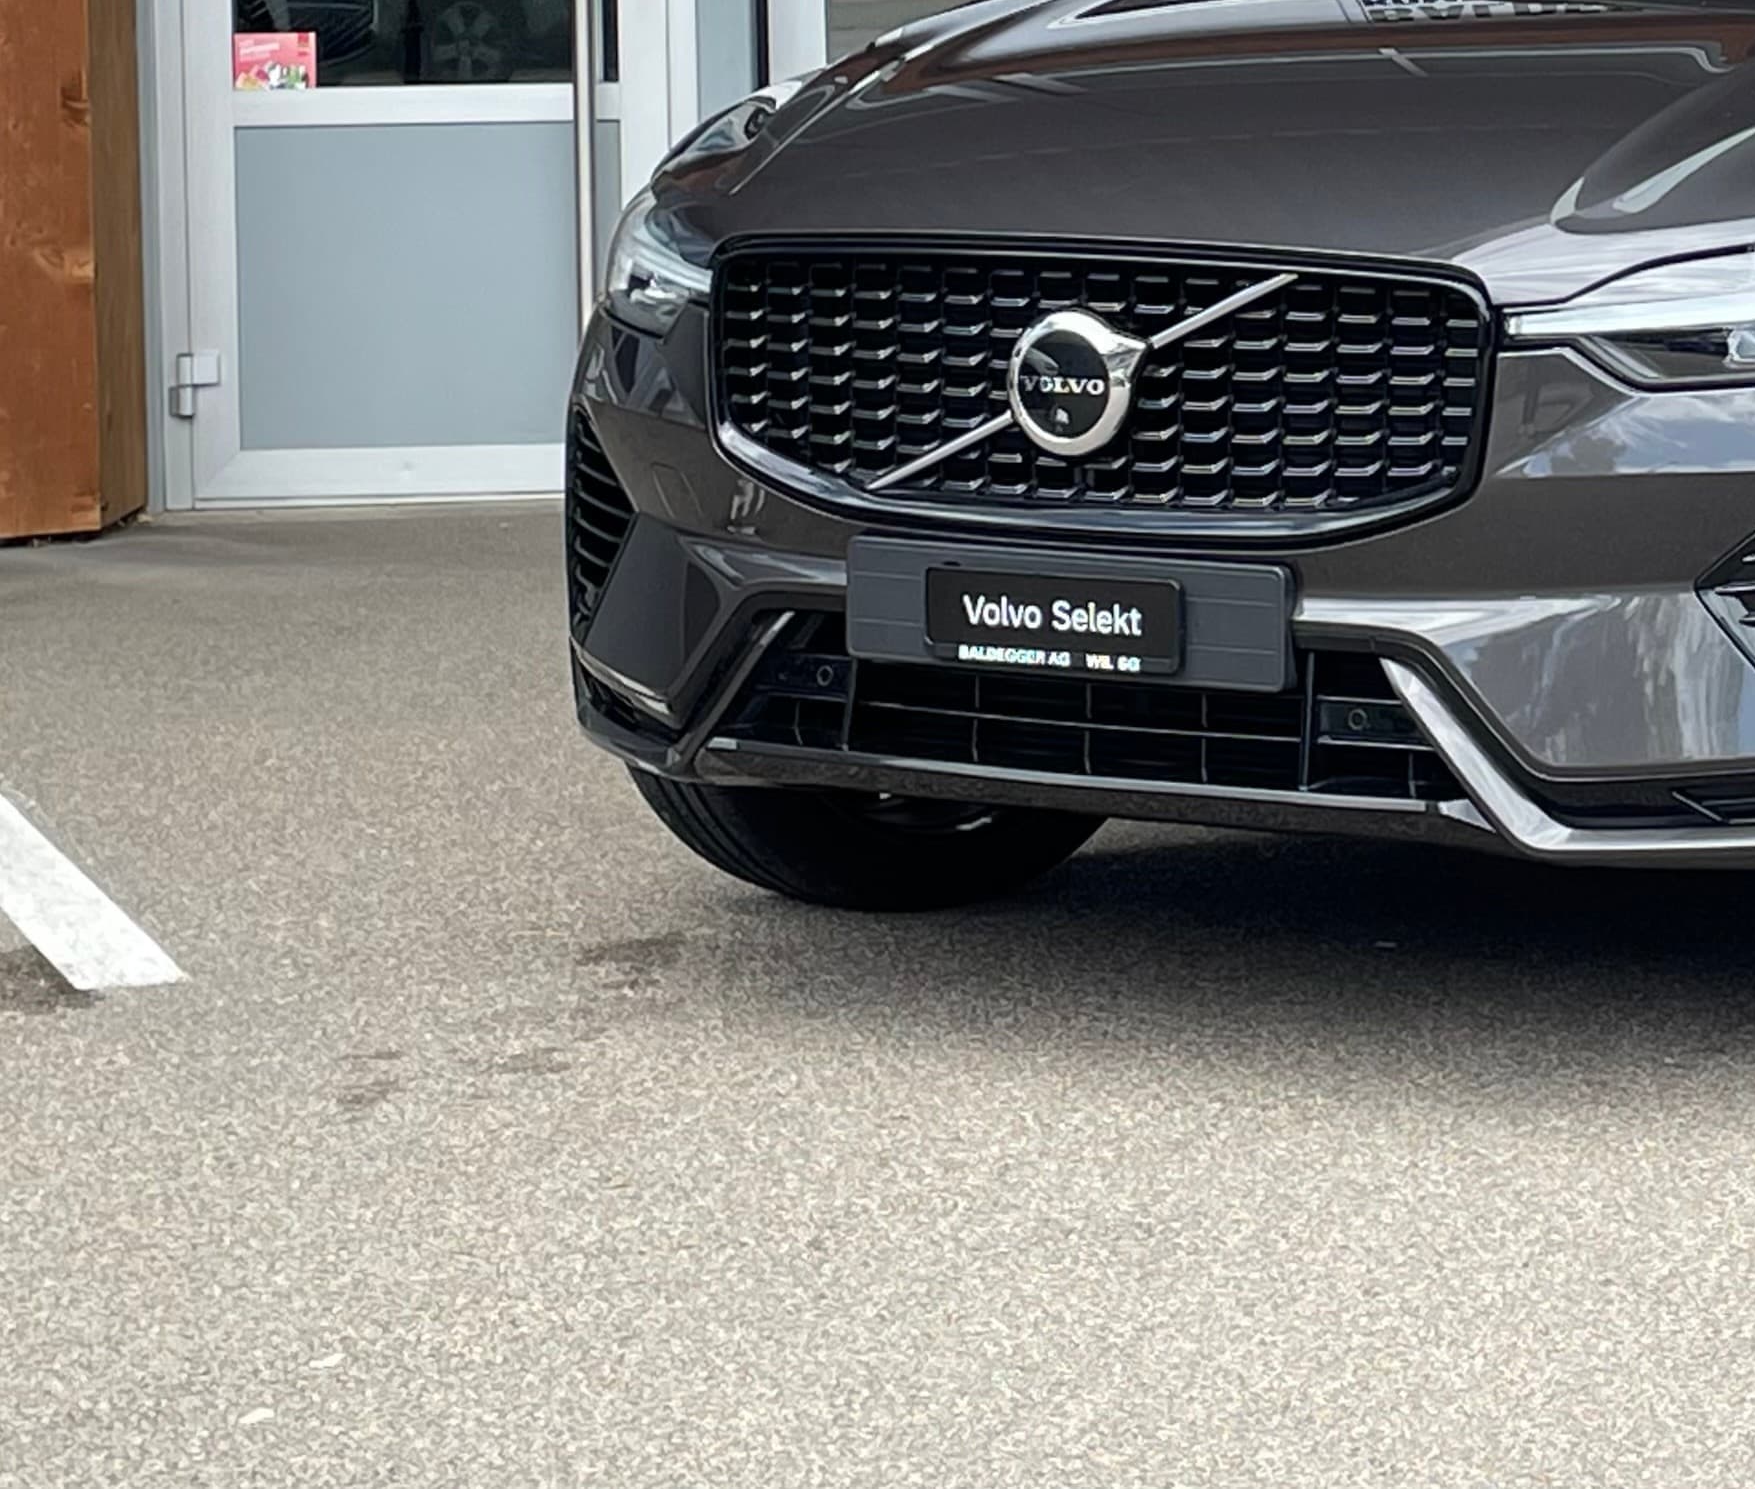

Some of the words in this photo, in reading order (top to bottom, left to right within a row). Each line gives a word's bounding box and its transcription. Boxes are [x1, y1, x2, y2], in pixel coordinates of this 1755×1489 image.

[1019, 374, 1106, 396] VOLVO
[962, 594, 1042, 629] Volvo
[1051, 599, 1143, 637] Selekt
[957, 644, 1046, 667] BALDEGGER
[1048, 652, 1072, 667] AG
